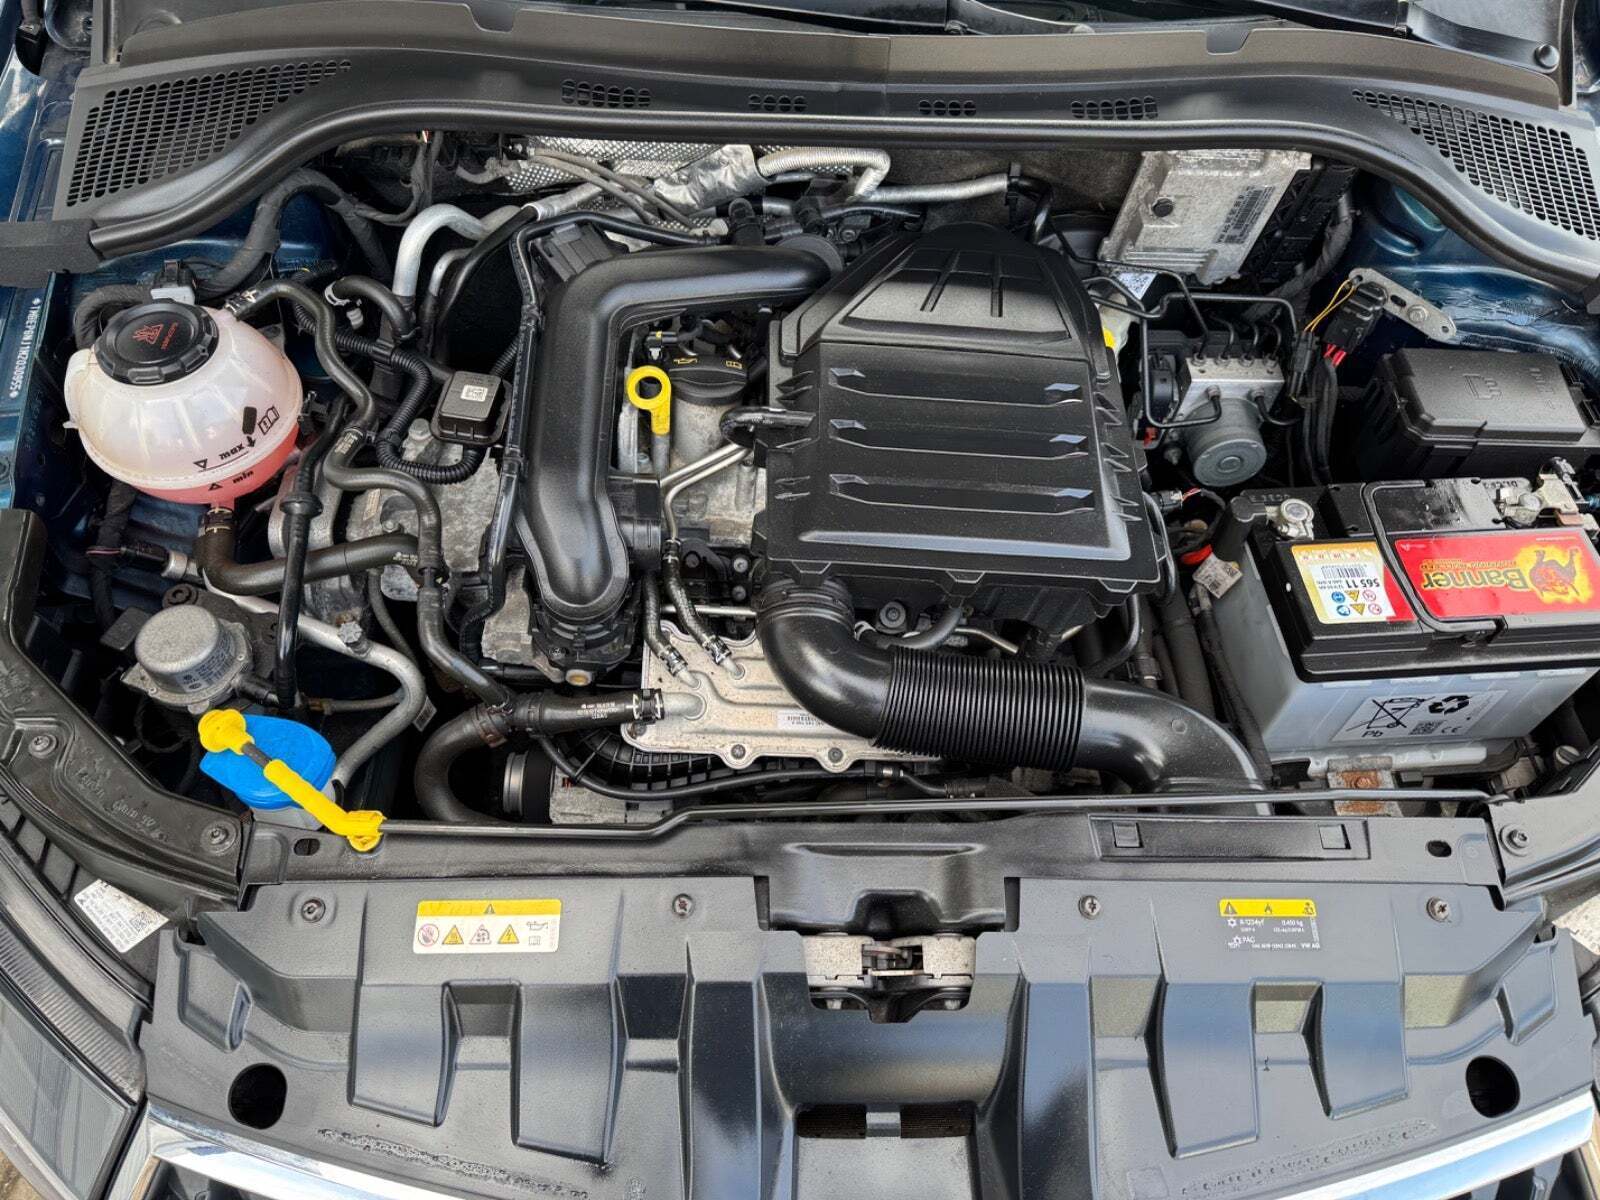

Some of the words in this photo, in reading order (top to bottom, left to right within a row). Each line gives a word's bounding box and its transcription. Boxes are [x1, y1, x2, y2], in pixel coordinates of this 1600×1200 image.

[218, 443, 245, 460] max
[232, 470, 254, 484] min
[1345, 579, 1359, 589] 11
[1360, 578, 1380, 588] 565
[1423, 568, 1529, 591] Banner
[1361, 730, 1384, 738] Pb
